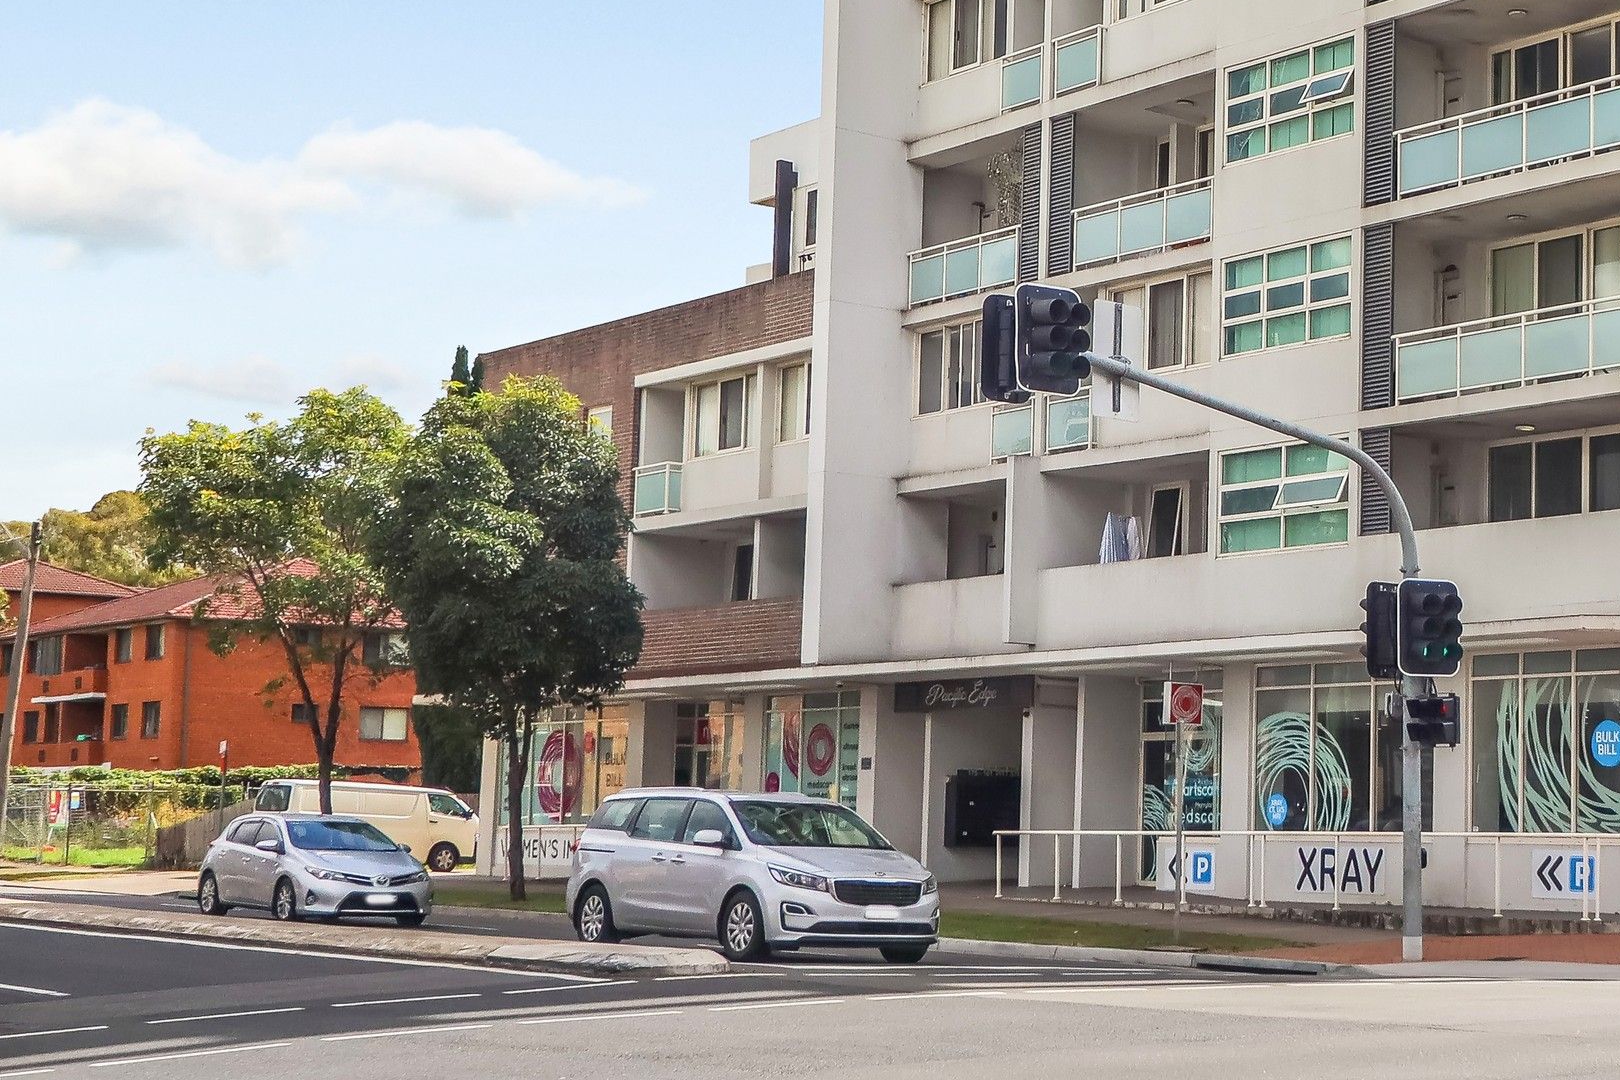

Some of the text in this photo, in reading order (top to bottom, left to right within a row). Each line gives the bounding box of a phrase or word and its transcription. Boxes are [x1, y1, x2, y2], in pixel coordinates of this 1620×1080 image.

[925, 679, 998, 708] Pacific Edge
[1594, 730, 1620, 744] BULK
[1596, 743, 1618, 756] BILL
[500, 838, 559, 860] MEN'S
[1197, 856, 1209, 880] P
[1296, 847, 1384, 894] XRAY
